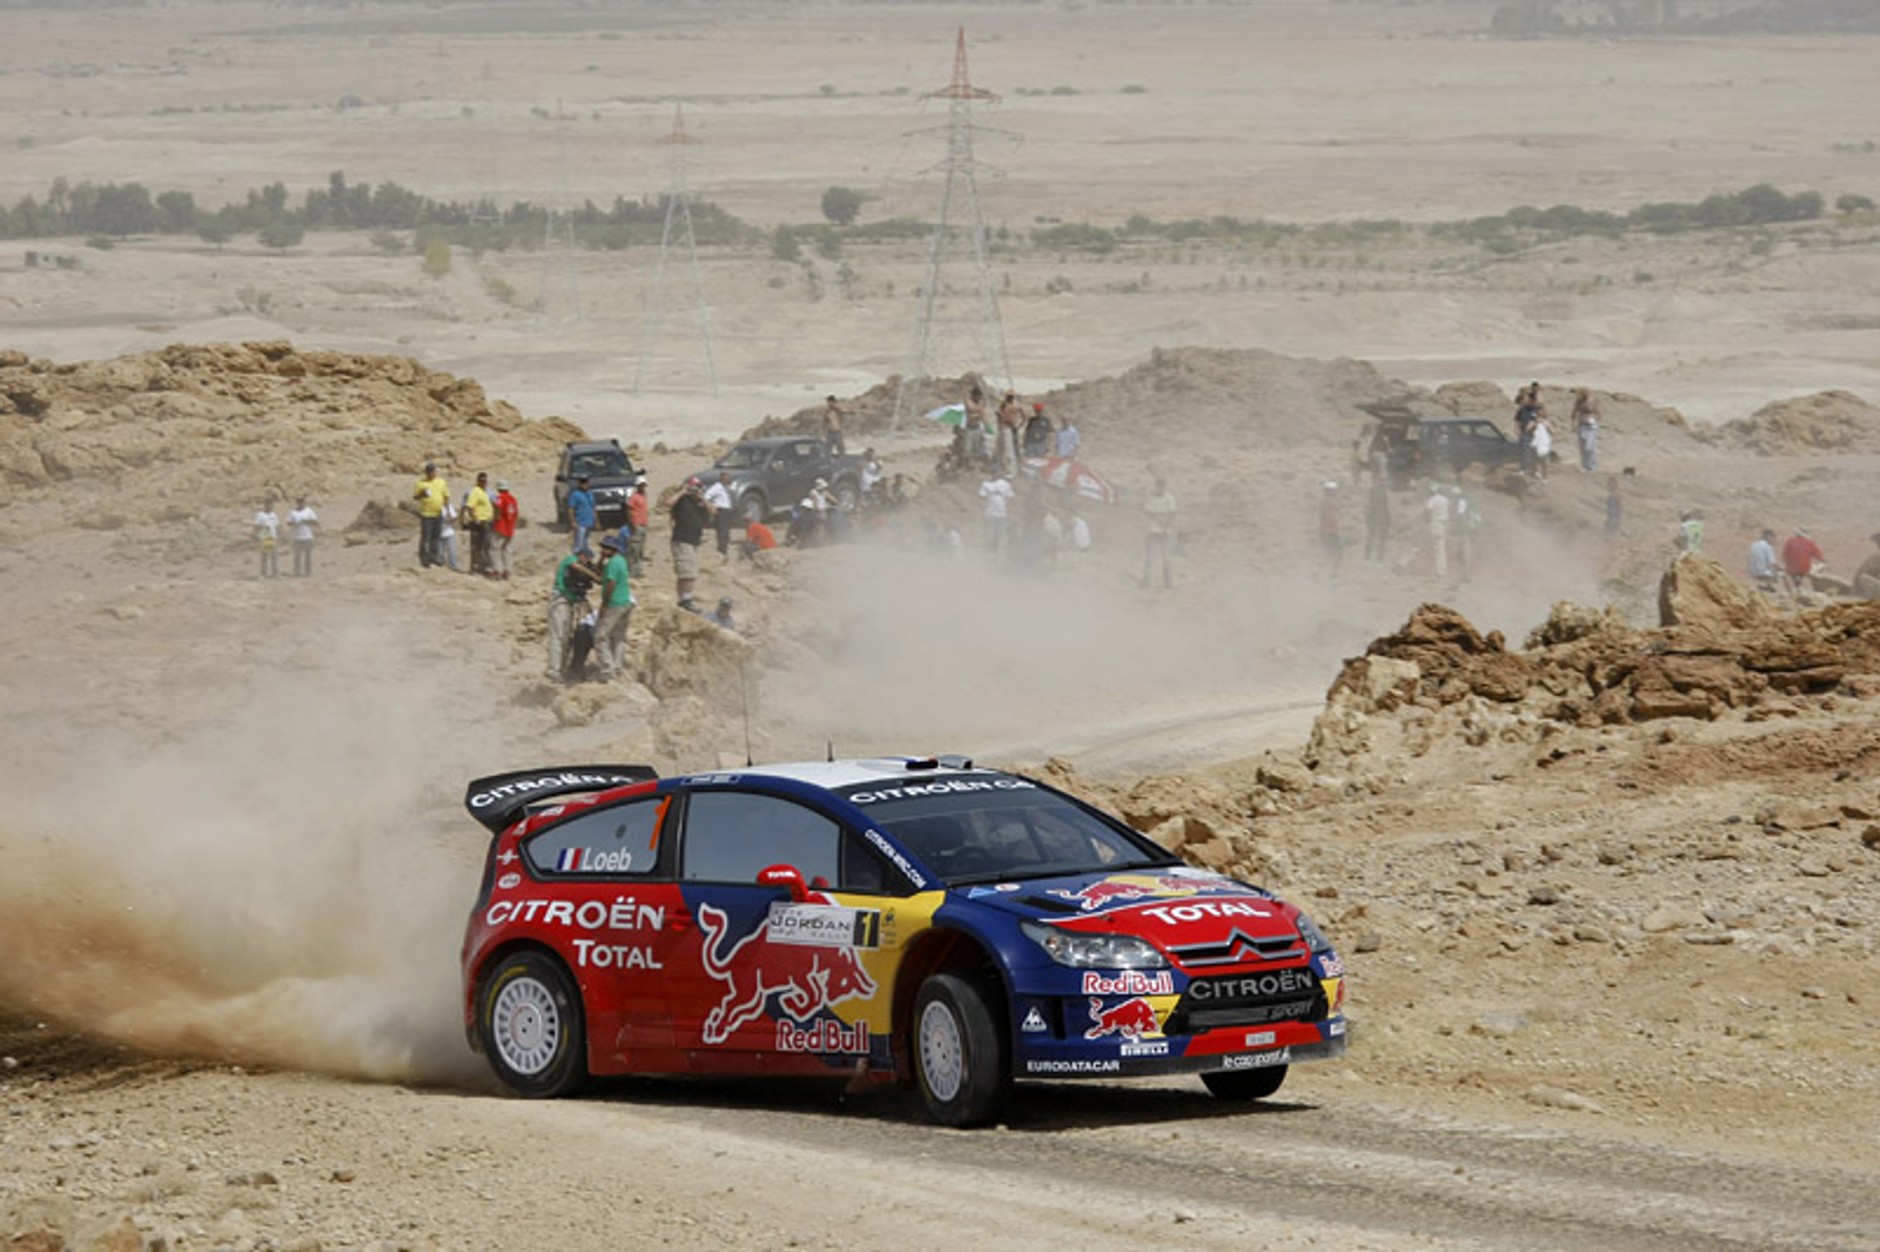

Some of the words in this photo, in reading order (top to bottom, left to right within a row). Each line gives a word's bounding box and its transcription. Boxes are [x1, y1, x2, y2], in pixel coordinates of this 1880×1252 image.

[649, 794, 672, 850] 1
[582, 848, 632, 871] Loeb
[485, 896, 665, 932] CITROËN
[1141, 902, 1272, 925] TOTAL
[770, 916, 850, 932] JORDAN
[861, 912, 873, 947] 1
[572, 939, 663, 969] TOTAL
[1081, 971, 1130, 994] Red
[1131, 970, 1174, 993] Bull
[1188, 969, 1313, 999] CITROËN
[776, 1018, 823, 1052] Red
[825, 1019, 870, 1053] Bull
